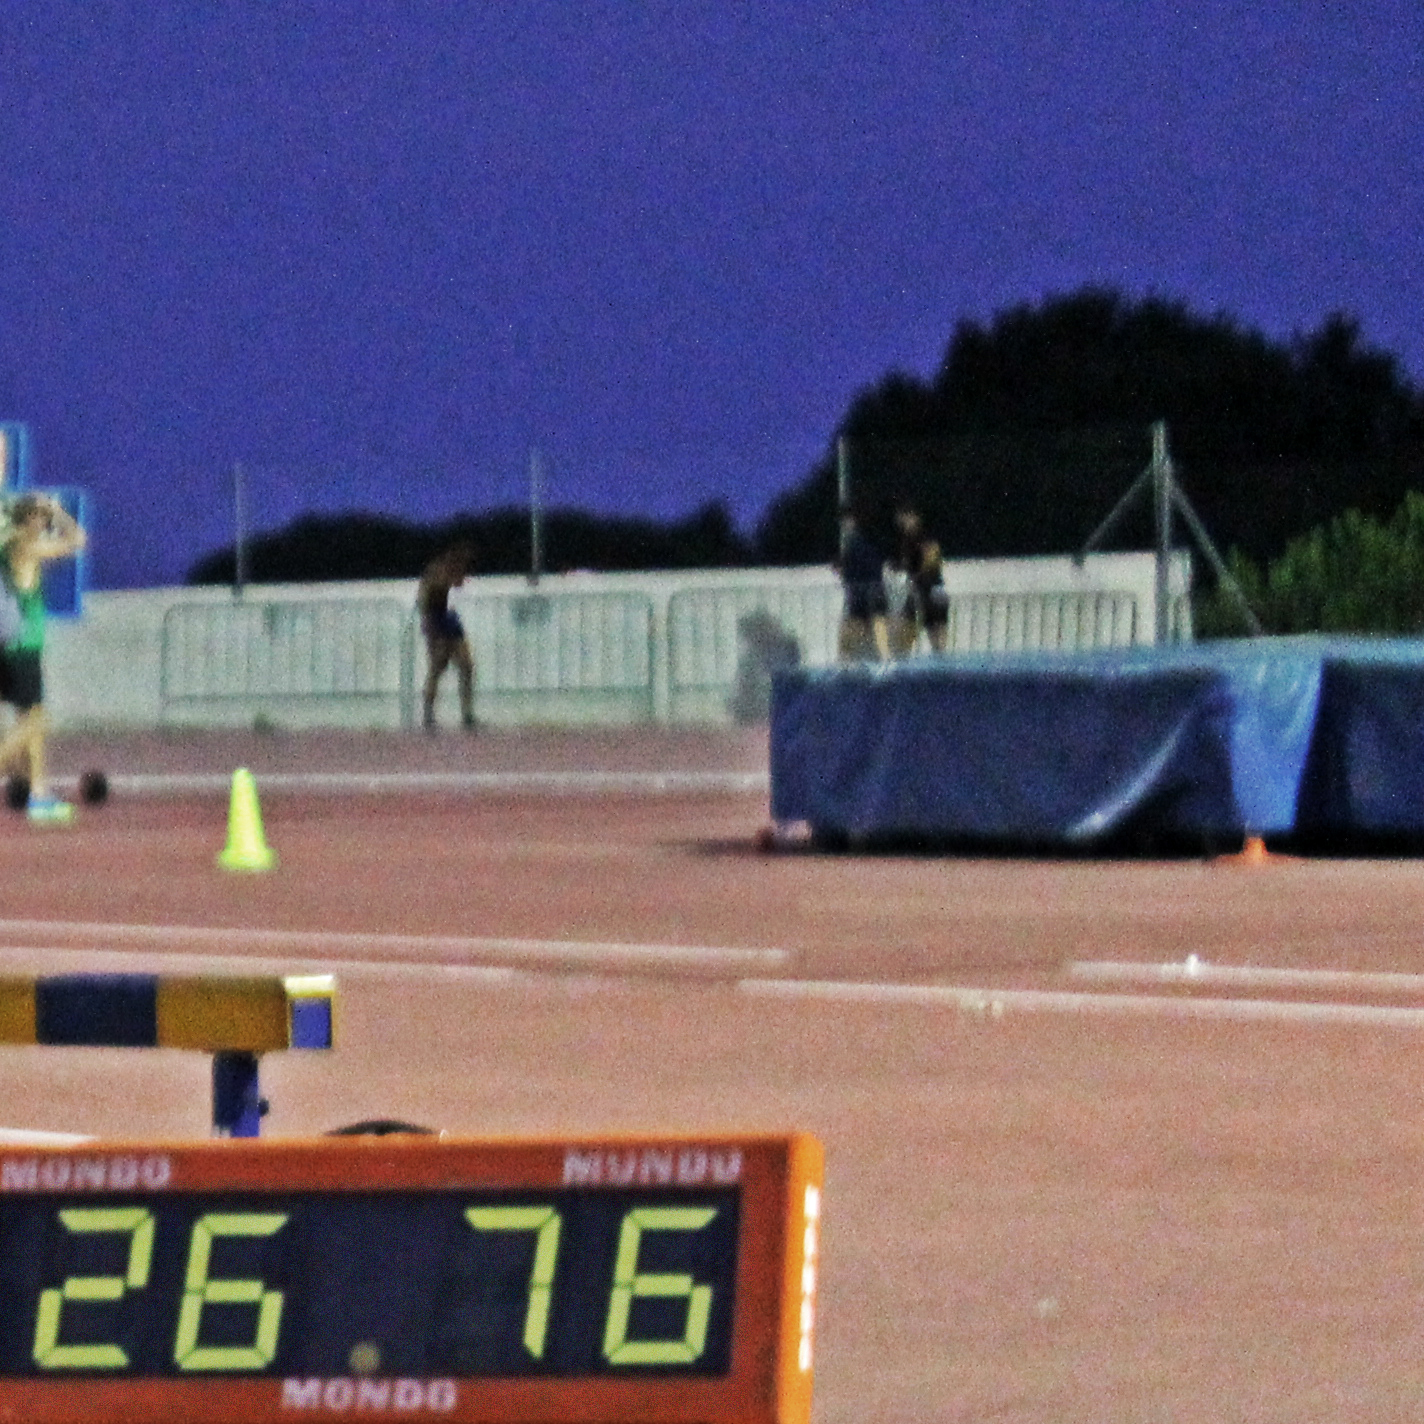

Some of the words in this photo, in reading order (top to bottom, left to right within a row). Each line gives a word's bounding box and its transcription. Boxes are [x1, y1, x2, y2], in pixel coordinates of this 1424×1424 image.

[32, 1208, 290, 1371] 26
[463, 1207, 718, 1365] 76
[282, 1377, 457, 1410] MONDO
